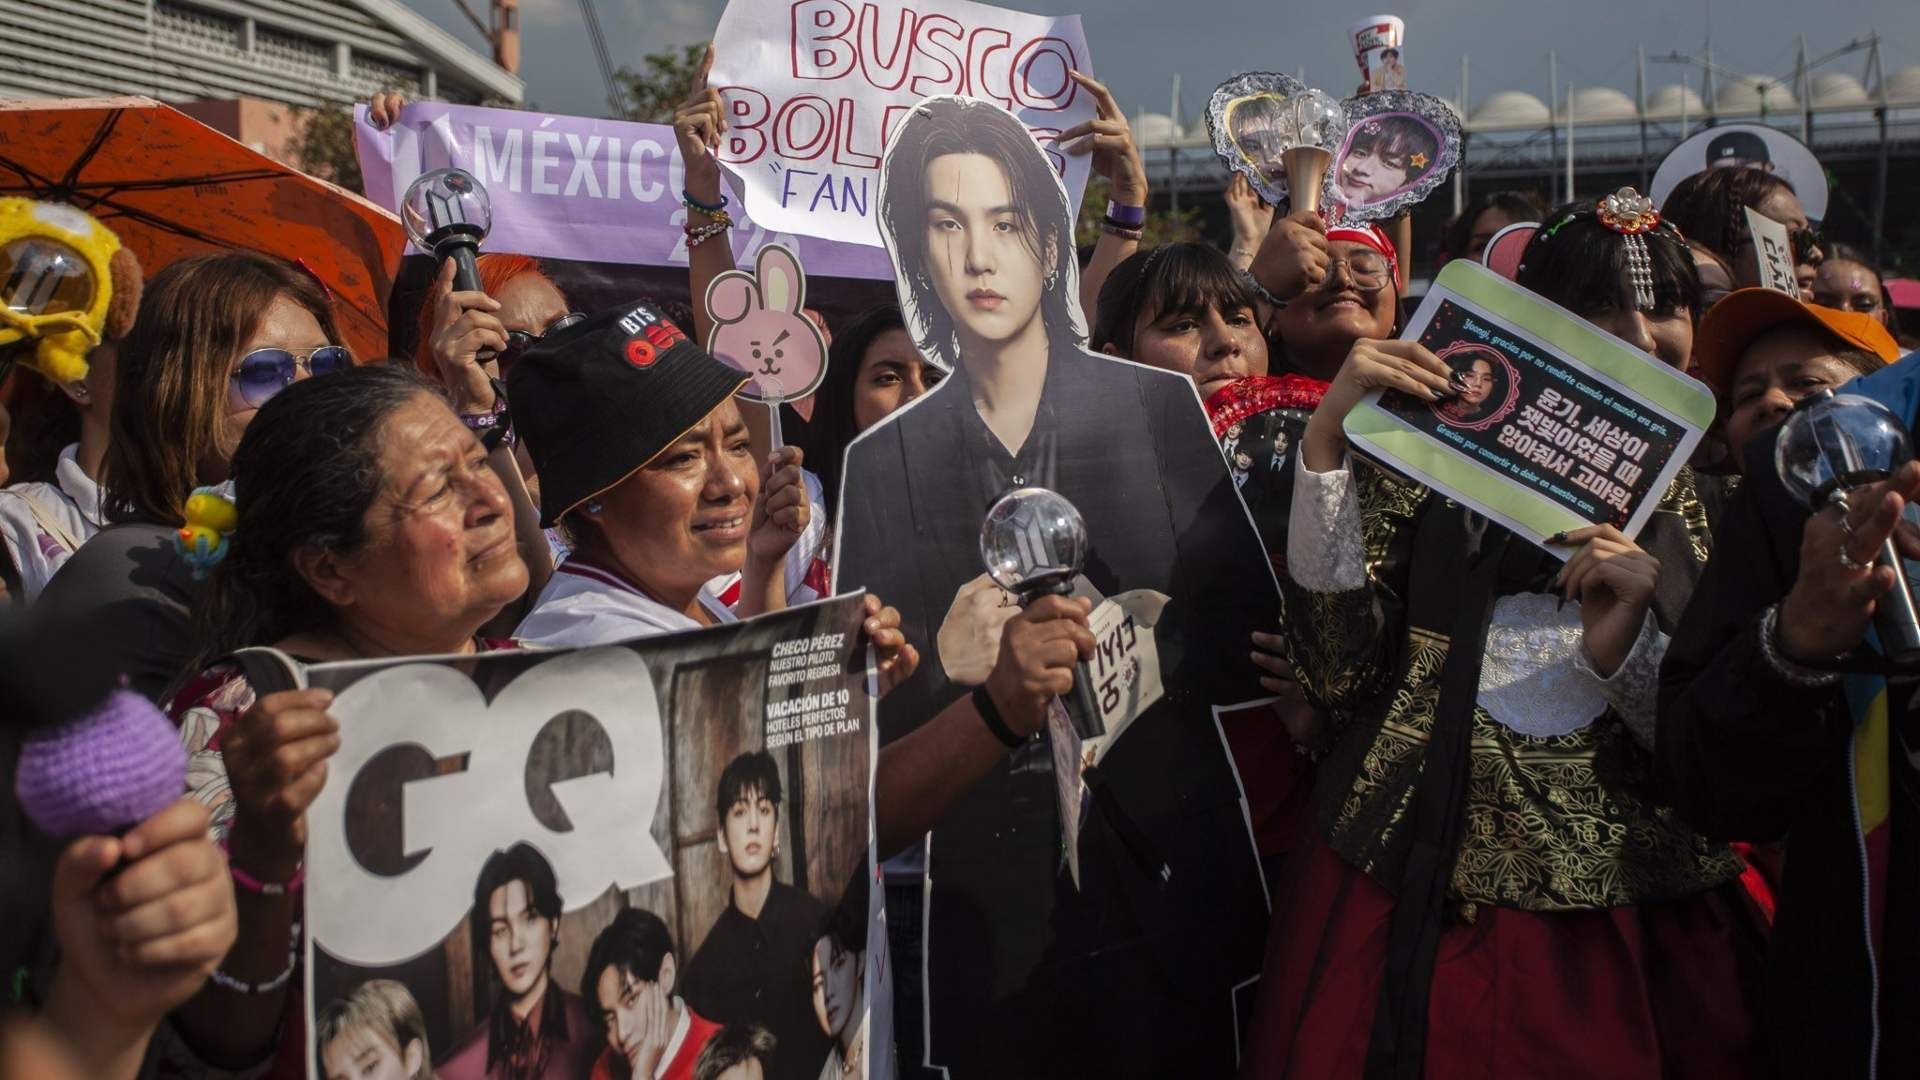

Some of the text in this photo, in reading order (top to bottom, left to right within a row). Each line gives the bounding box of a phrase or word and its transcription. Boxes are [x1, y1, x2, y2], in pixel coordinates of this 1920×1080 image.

[791, 0, 1077, 111] BUSCO
[619, 306, 656, 334] BTS
[1463, 318, 1491, 340] Yoongi,
[1490, 336, 1520, 354] gracias
[1518, 350, 1535, 361] por
[1533, 358, 1546, 368] no
[1544, 364, 1576, 385] rendirte
[1575, 382, 1604, 401] cuando
[1603, 397, 1614, 406] el
[1611, 402, 1638, 419] mundo
[1636, 415, 1652, 427] era
[1516, 404, 1643, 488] 잿빛이었을 때
[1536, 387, 1650, 462] 윤기, 세상이
[1436, 423, 1465, 444] Gracias
[1462, 440, 1479, 451] por
[1478, 447, 1512, 468] convertir
[1510, 464, 1521, 474] tu
[1519, 469, 1540, 482] dolor
[1539, 480, 1550, 489] en
[1549, 485, 1577, 504] nuestra
[1496, 424, 1632, 514] 않아줘서 고마워.
[769, 650, 835, 673] NUESTRO PILOTO
[772, 632, 845, 659] CHECO PÉREZ
[768, 663, 841, 688] FAVORITO REGRESA
[767, 688, 850, 720] VACACIÓN DE 10
[767, 706, 846, 735] HOTELES PERFECTOS
[794, 729, 804, 744] EL
[804, 725, 823, 741] TIPO
[823, 722, 837, 737] DE
[837, 718, 860, 735] PLAN
[307, 644, 675, 967] GQ
